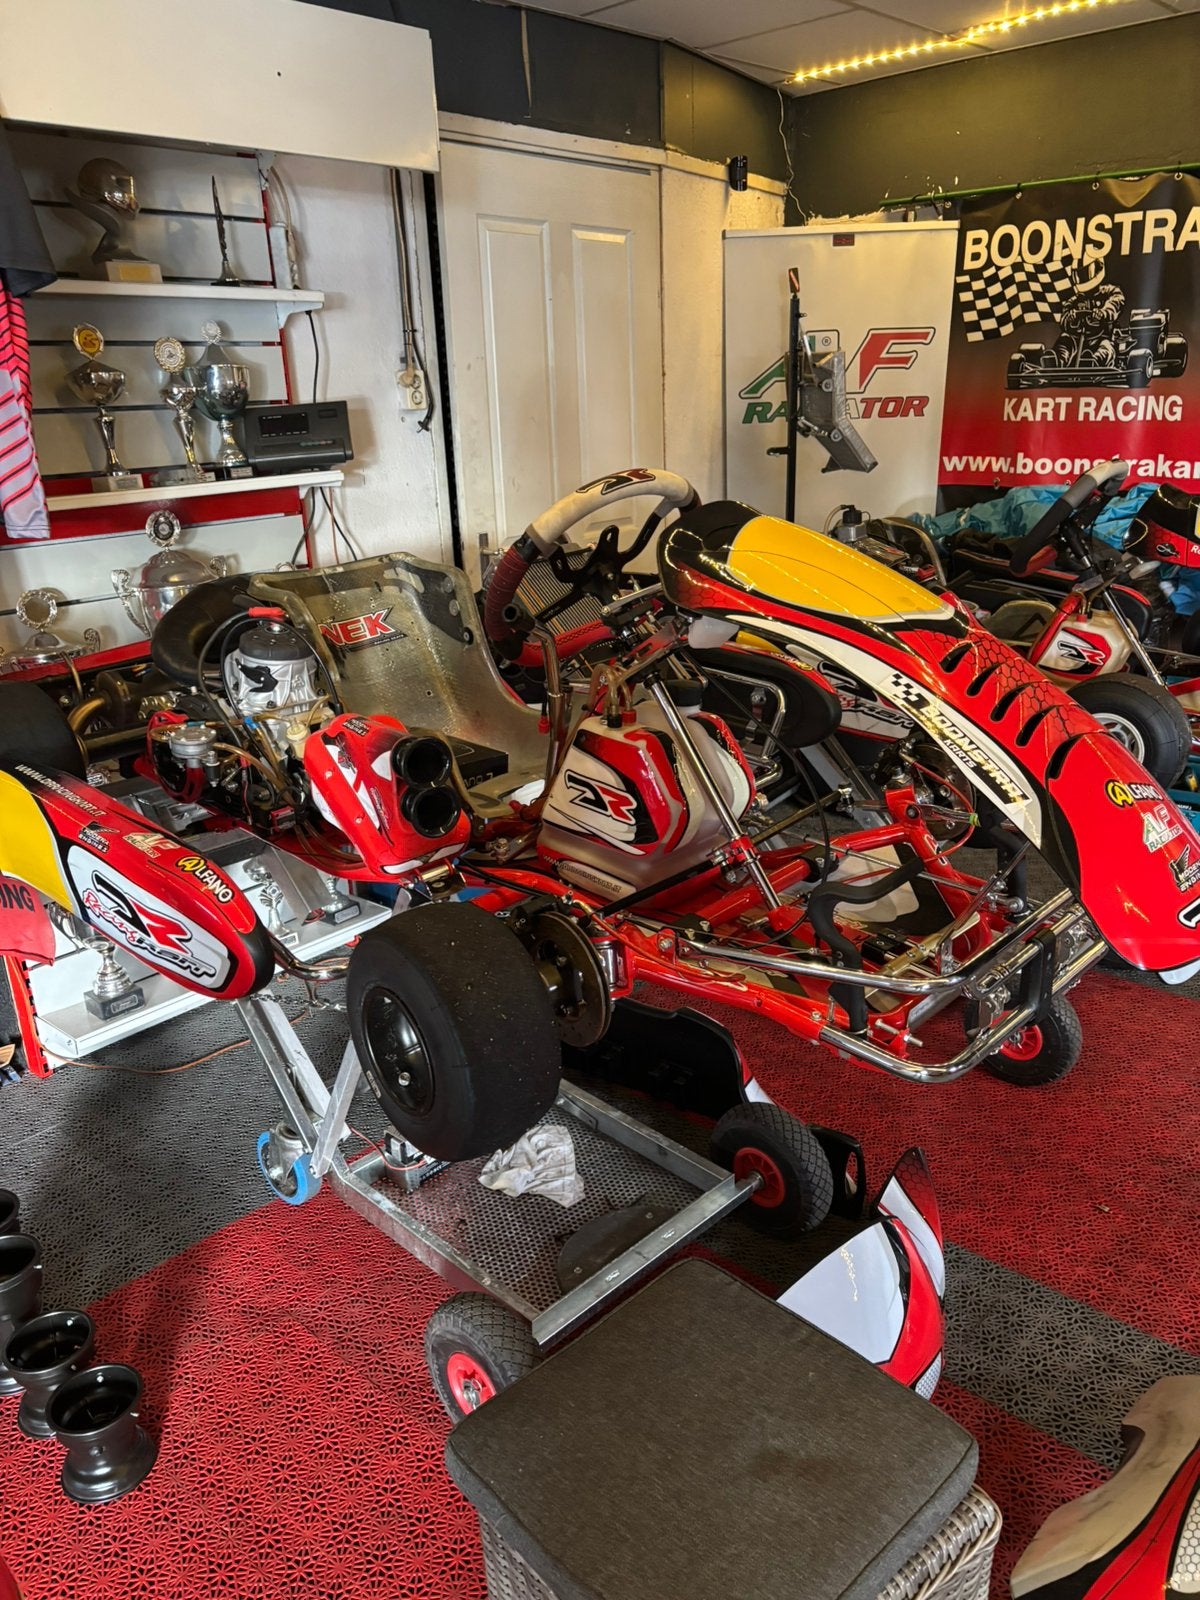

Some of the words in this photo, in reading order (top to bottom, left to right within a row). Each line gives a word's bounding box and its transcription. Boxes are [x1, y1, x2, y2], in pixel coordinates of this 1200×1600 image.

[963, 206, 1200, 270] BOONSTRA
[742, 396, 930, 424] RAATOR
[1003, 397, 1072, 422] KART
[1077, 395, 1183, 422] RACING
[943, 452, 1200, 479] www.boonraka
[920, 704, 1024, 802] BOONSTRA
[944, 739, 977, 769] KARTS
[177, 857, 233, 903] ALFANO
